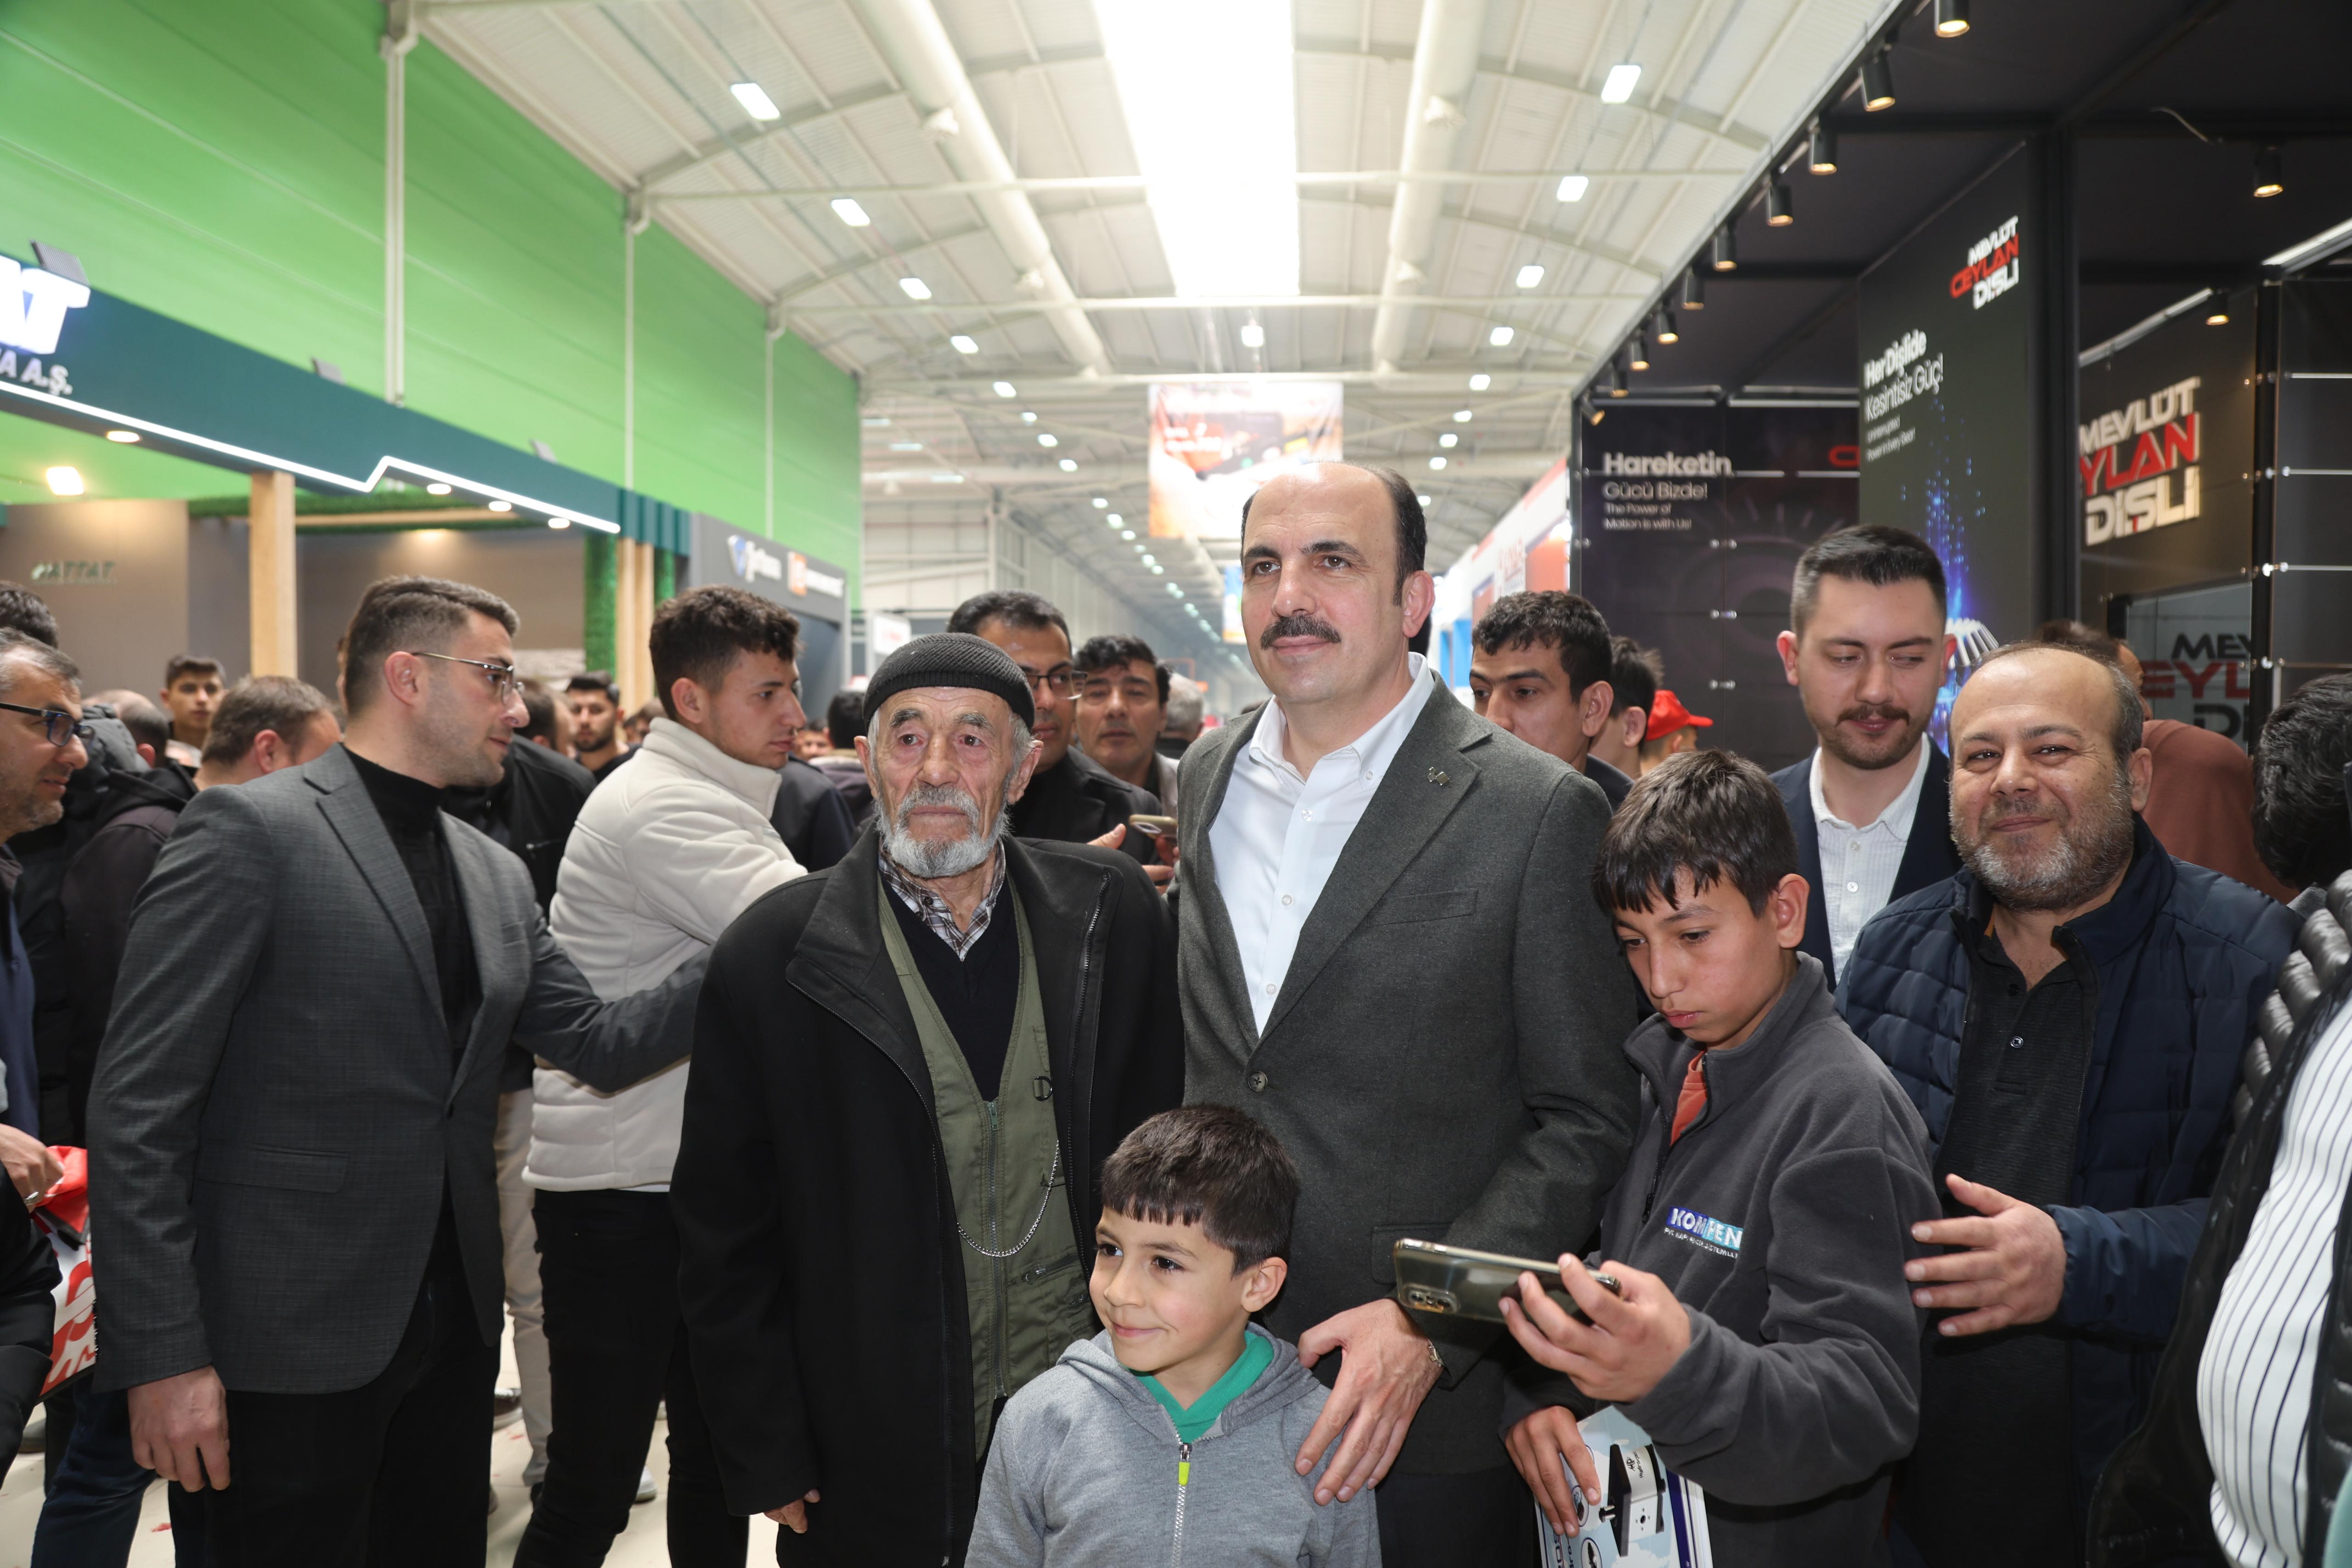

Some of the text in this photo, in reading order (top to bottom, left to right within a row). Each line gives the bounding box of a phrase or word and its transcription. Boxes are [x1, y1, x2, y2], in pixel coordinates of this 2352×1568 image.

[1950, 232, 2019, 298] CEYLAN
[1912, 352, 1944, 395] Güç!
[1603, 450, 1733, 478] Hareketin
[2080, 412, 2199, 496] YLAN
[1602, 481, 1707, 500] Gücü Bizde!
[1604, 517, 1641, 530] Motion
[1653, 517, 1675, 530] with
[1627, 502, 1658, 515] Power
[1670, 1207, 1743, 1249] KOMPEN
